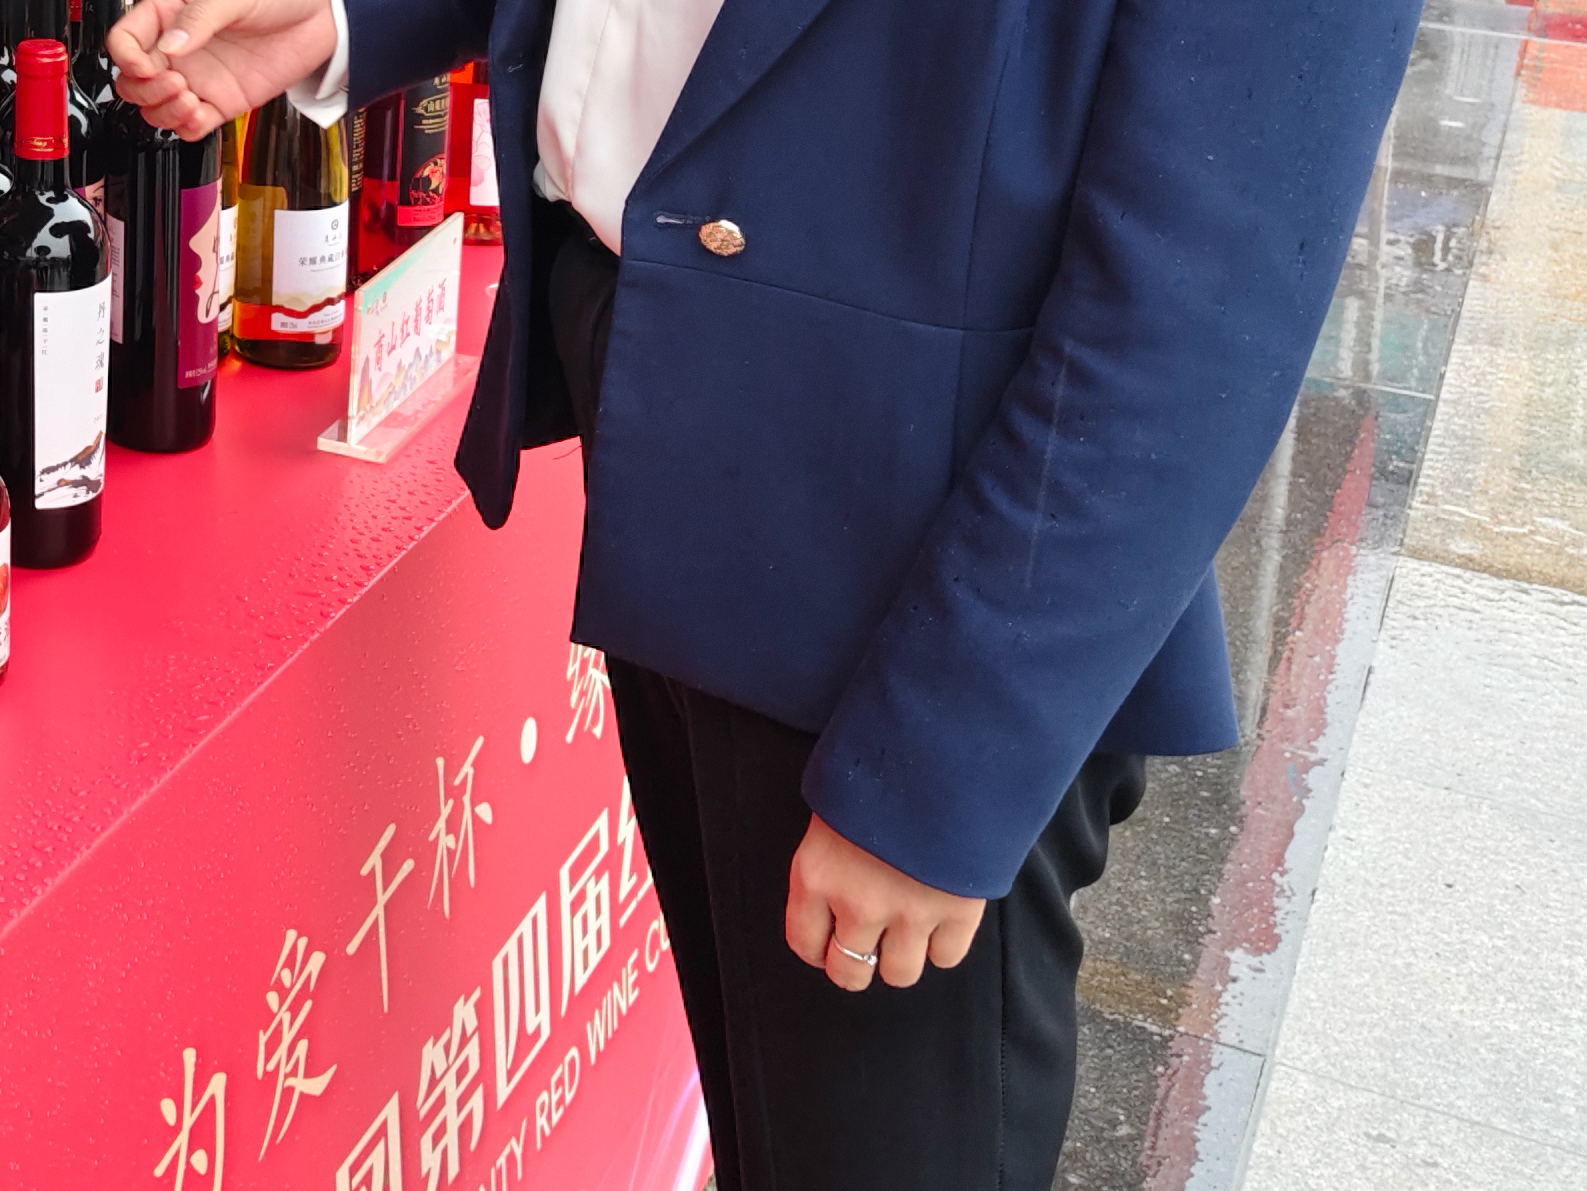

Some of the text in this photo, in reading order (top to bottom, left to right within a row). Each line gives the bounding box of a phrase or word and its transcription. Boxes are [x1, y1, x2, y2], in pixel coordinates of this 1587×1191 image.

[373, 277, 447, 373] 商山红葡萄酒
[535, 1045, 581, 1151] RED
[586, 948, 640, 1066] WINE
